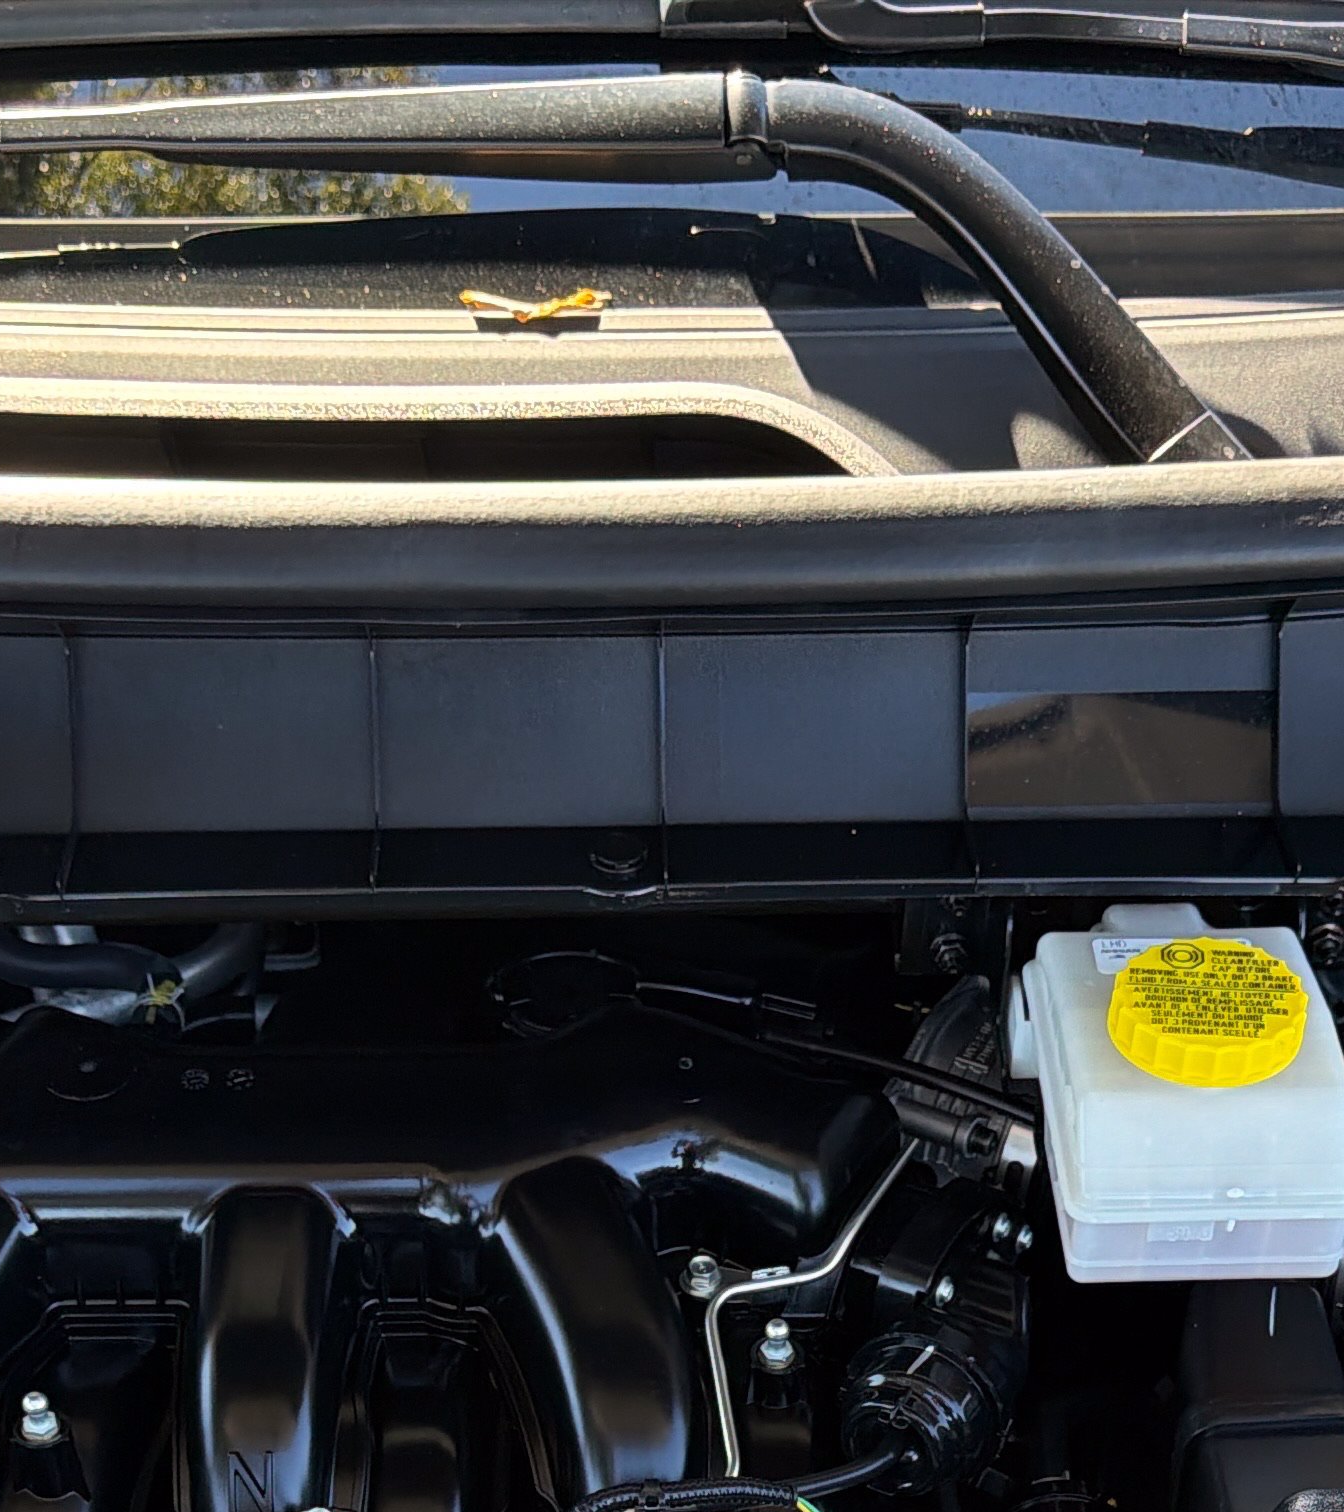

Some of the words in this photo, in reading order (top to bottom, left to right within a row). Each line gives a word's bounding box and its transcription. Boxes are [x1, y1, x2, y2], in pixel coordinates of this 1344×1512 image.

[1203, 972, 1229, 980] ONLY
[1262, 974, 1294, 982] BRAKE
[1160, 977, 1188, 985] FROM
[1201, 980, 1239, 988] SEALED
[1145, 994, 1188, 1003] BOUCHON
[1191, 996, 1202, 1004] DE
[1206, 997, 1274, 1007] REMPLISSAGE
[1134, 1001, 1167, 1009] AVANT
[1245, 1007, 1289, 1016] UTILISER
[1228, 1014, 1264, 1022] LIQUIDE
[1182, 1019, 1239, 1028] PROVENANT
[1162, 1026, 1219, 1036] CONTENANT
